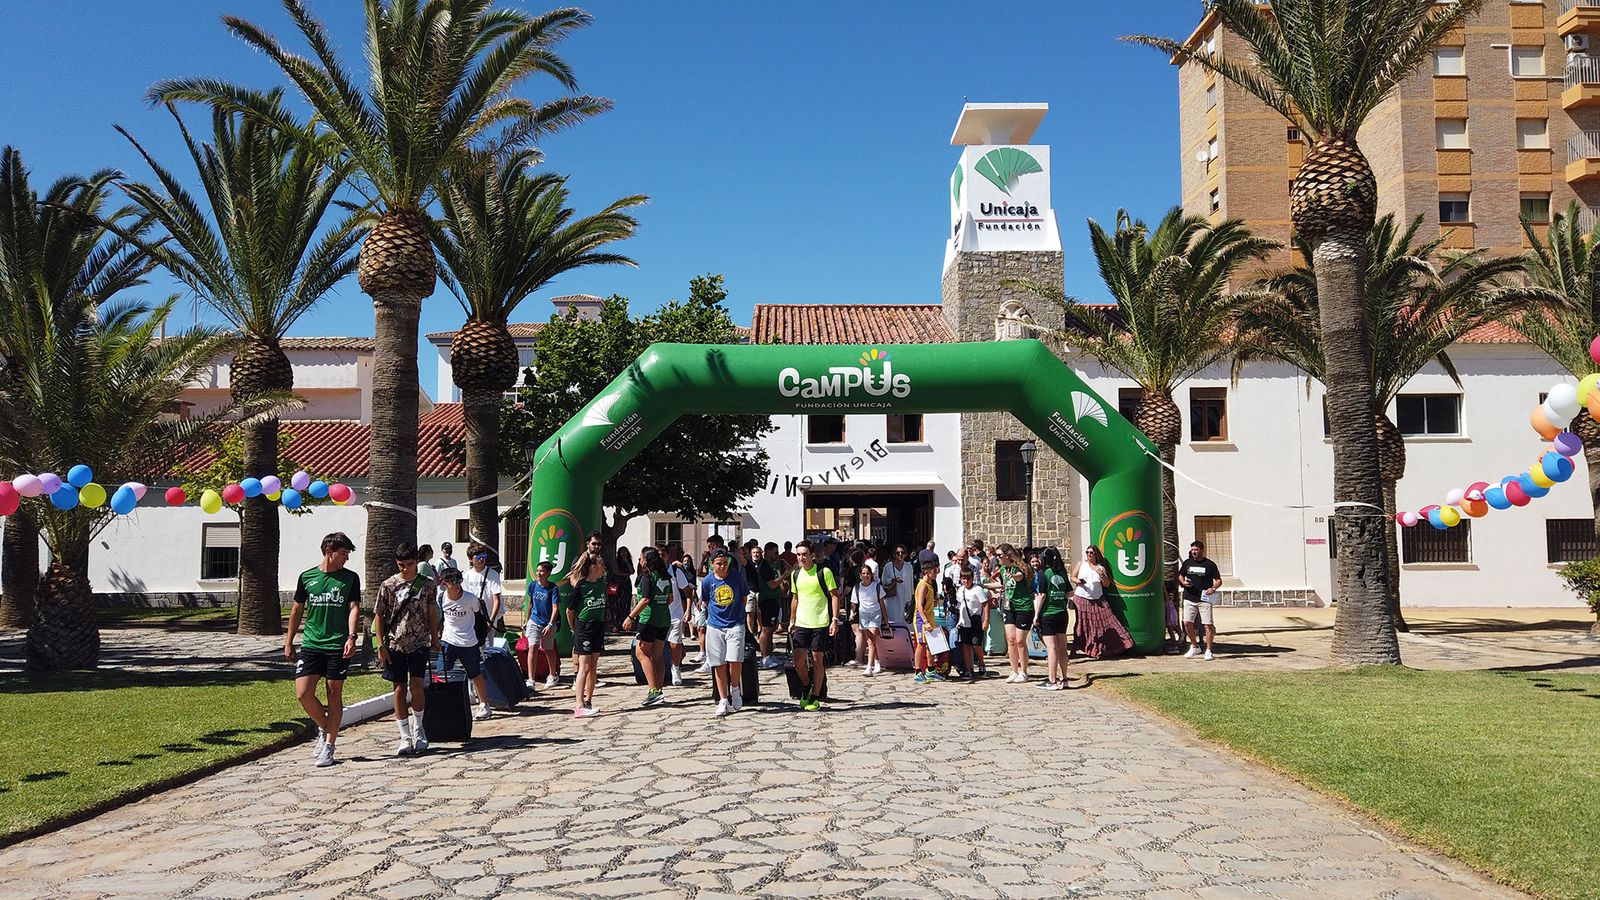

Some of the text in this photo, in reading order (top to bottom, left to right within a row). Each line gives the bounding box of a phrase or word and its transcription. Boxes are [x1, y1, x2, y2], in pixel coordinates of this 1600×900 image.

[980, 201, 1038, 218] Unicaja
[978, 222, 1041, 230] Fundación
[600, 412, 638, 447] Fundación
[613, 425, 642, 450] Unicaja
[1048, 424, 1075, 450] Unicaja
[1051, 411, 1090, 448] Fundación
